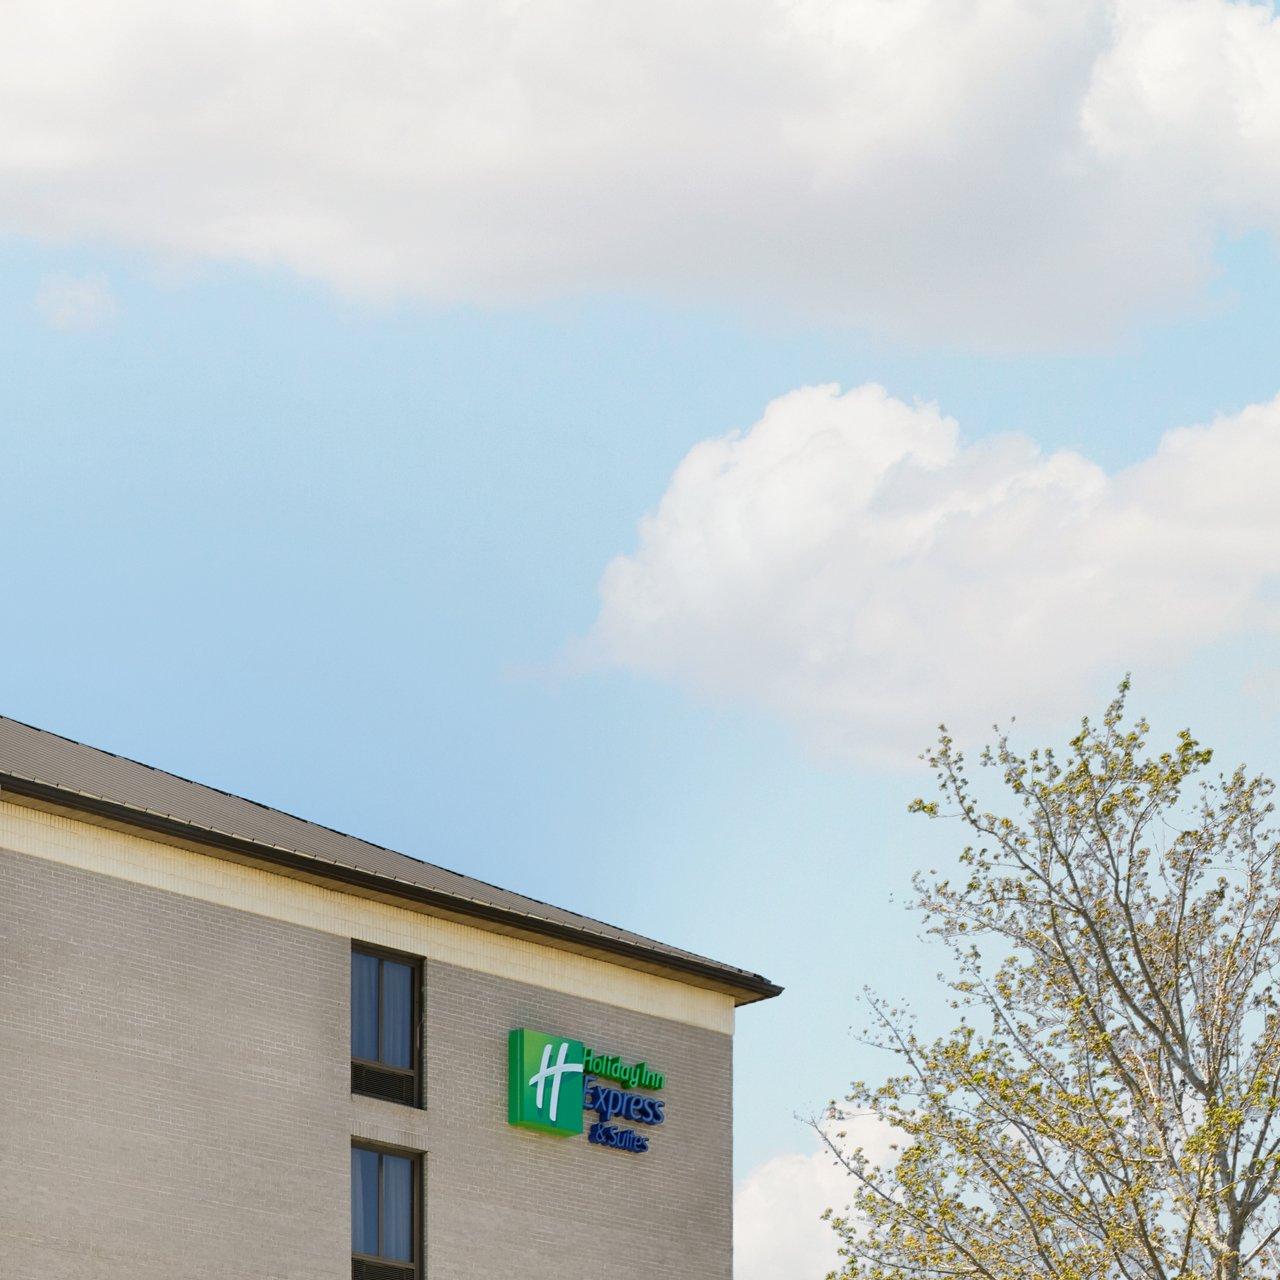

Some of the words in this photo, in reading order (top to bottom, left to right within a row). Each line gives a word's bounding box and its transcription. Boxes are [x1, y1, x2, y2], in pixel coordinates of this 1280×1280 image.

[583, 1047, 640, 1088] Holiday
[641, 1062, 666, 1088] Inn
[583, 1075, 665, 1124] Express
[608, 1126, 649, 1152] Suites
